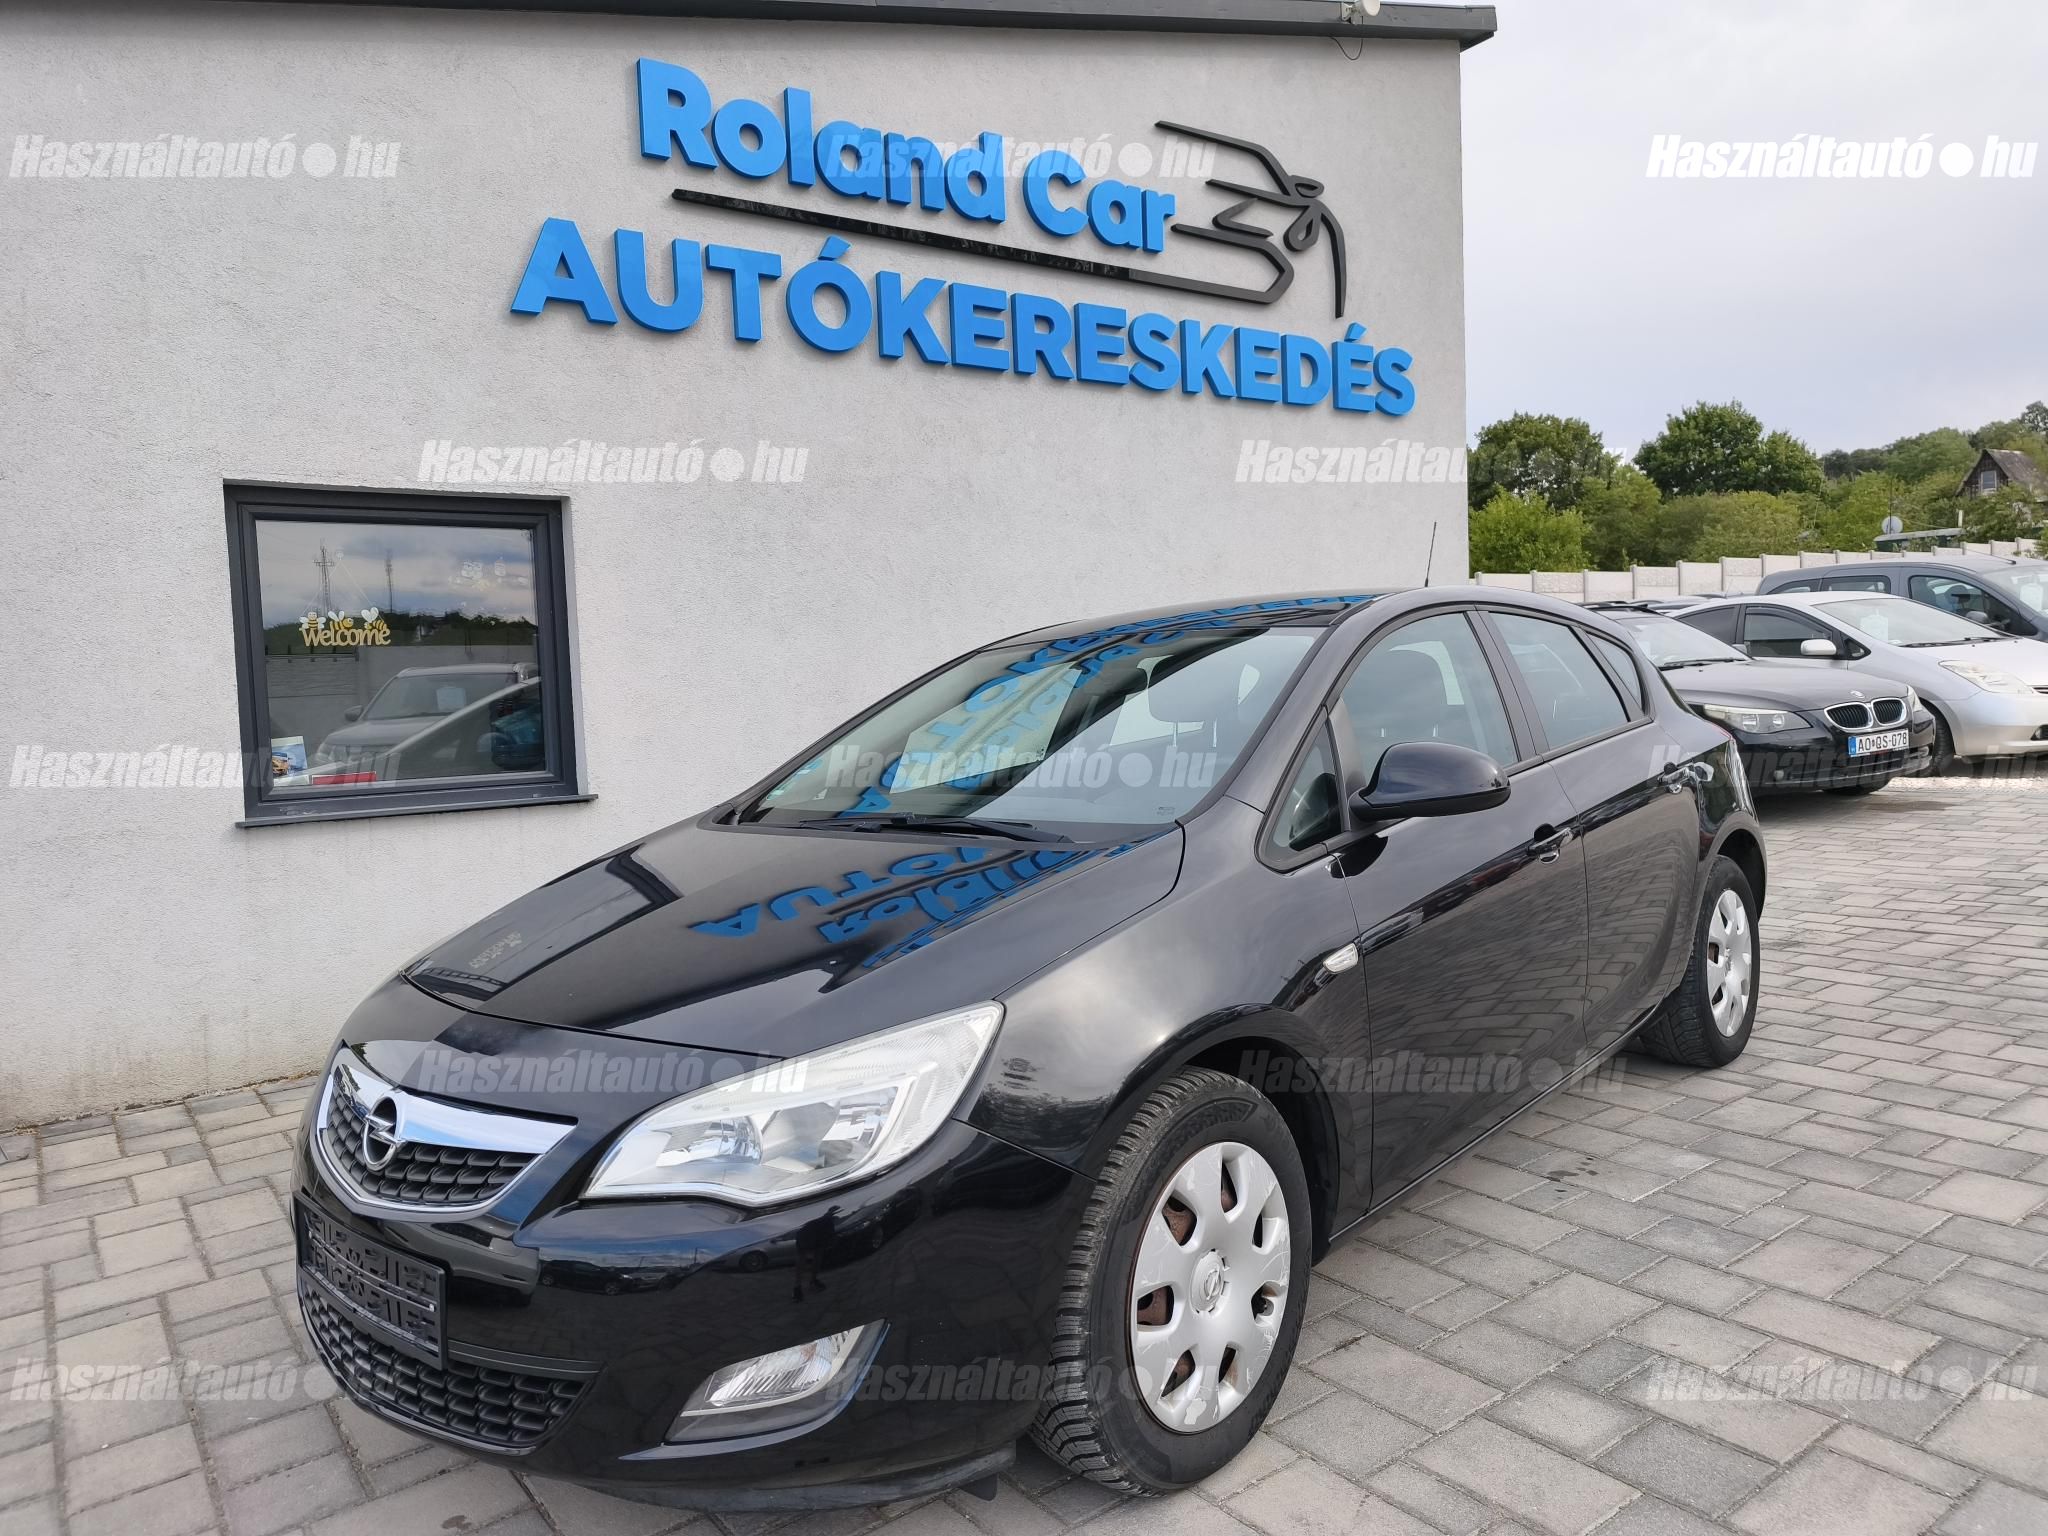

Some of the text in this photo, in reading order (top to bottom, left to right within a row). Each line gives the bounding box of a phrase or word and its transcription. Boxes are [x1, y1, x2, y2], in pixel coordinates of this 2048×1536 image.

[636, 57, 1176, 253] Roland Car
[510, 217, 1416, 417] AUTÓKERESKEDÉS
[299, 621, 391, 647] Welcome
